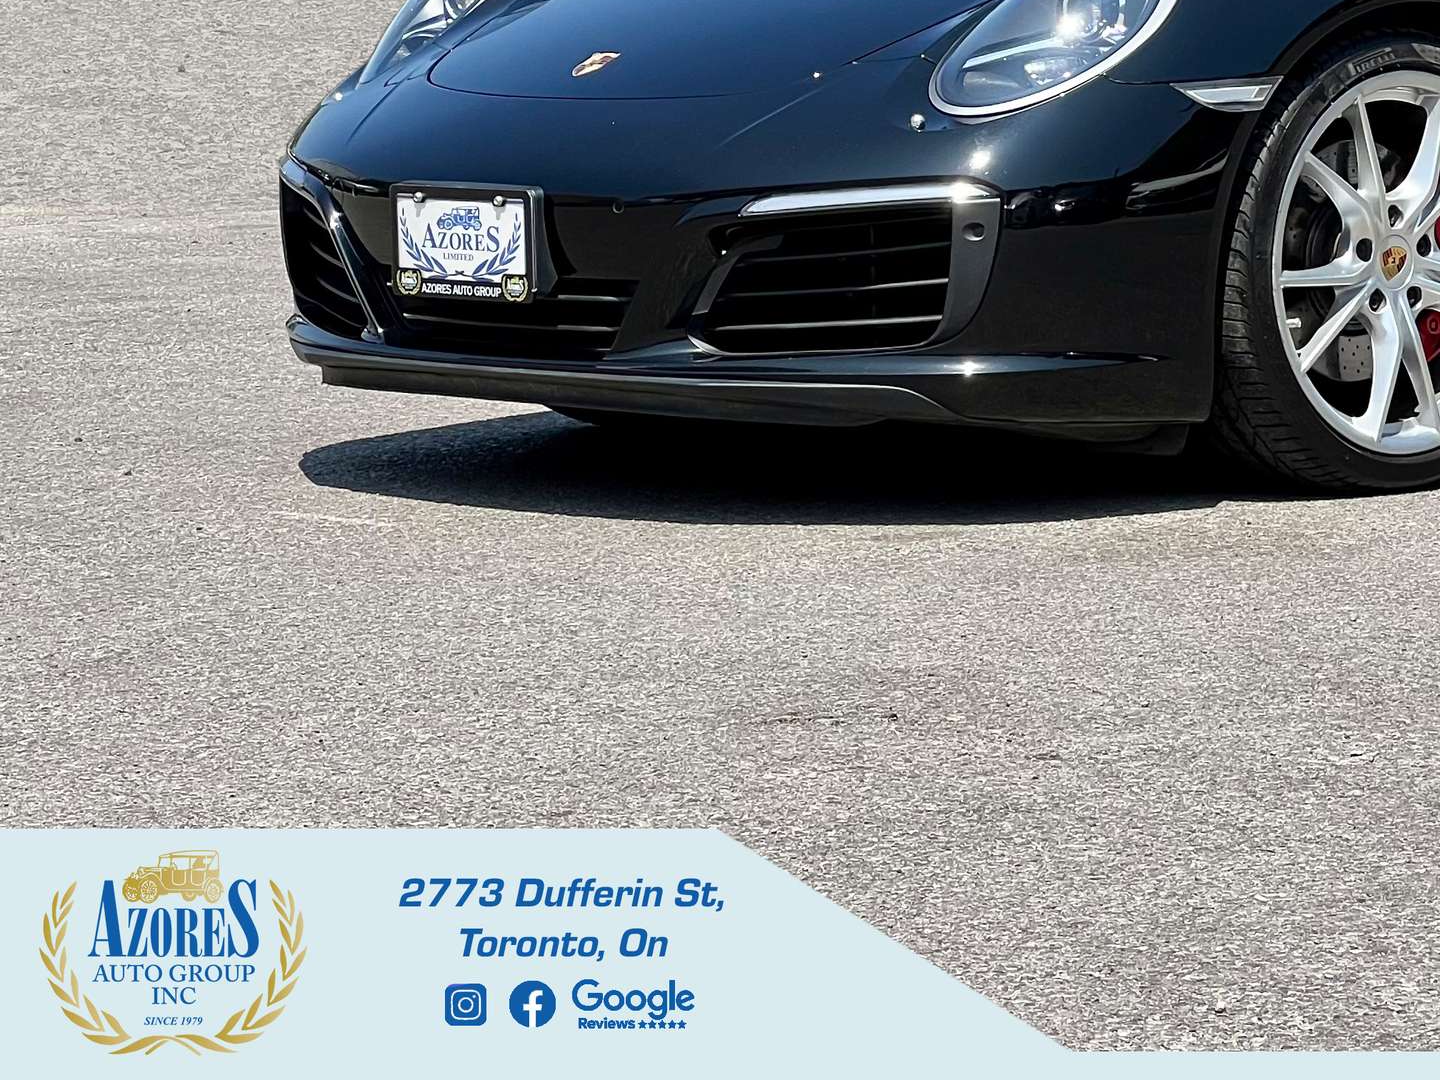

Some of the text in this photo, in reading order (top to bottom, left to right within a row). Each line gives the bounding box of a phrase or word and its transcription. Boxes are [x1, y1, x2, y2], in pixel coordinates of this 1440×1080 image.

[422, 223, 500, 253] AZORES
[443, 252, 474, 262] LIMITED
[421, 283, 452, 295] AZORES
[452, 284, 473, 296] AUTO
[474, 286, 501, 298] GROUP
